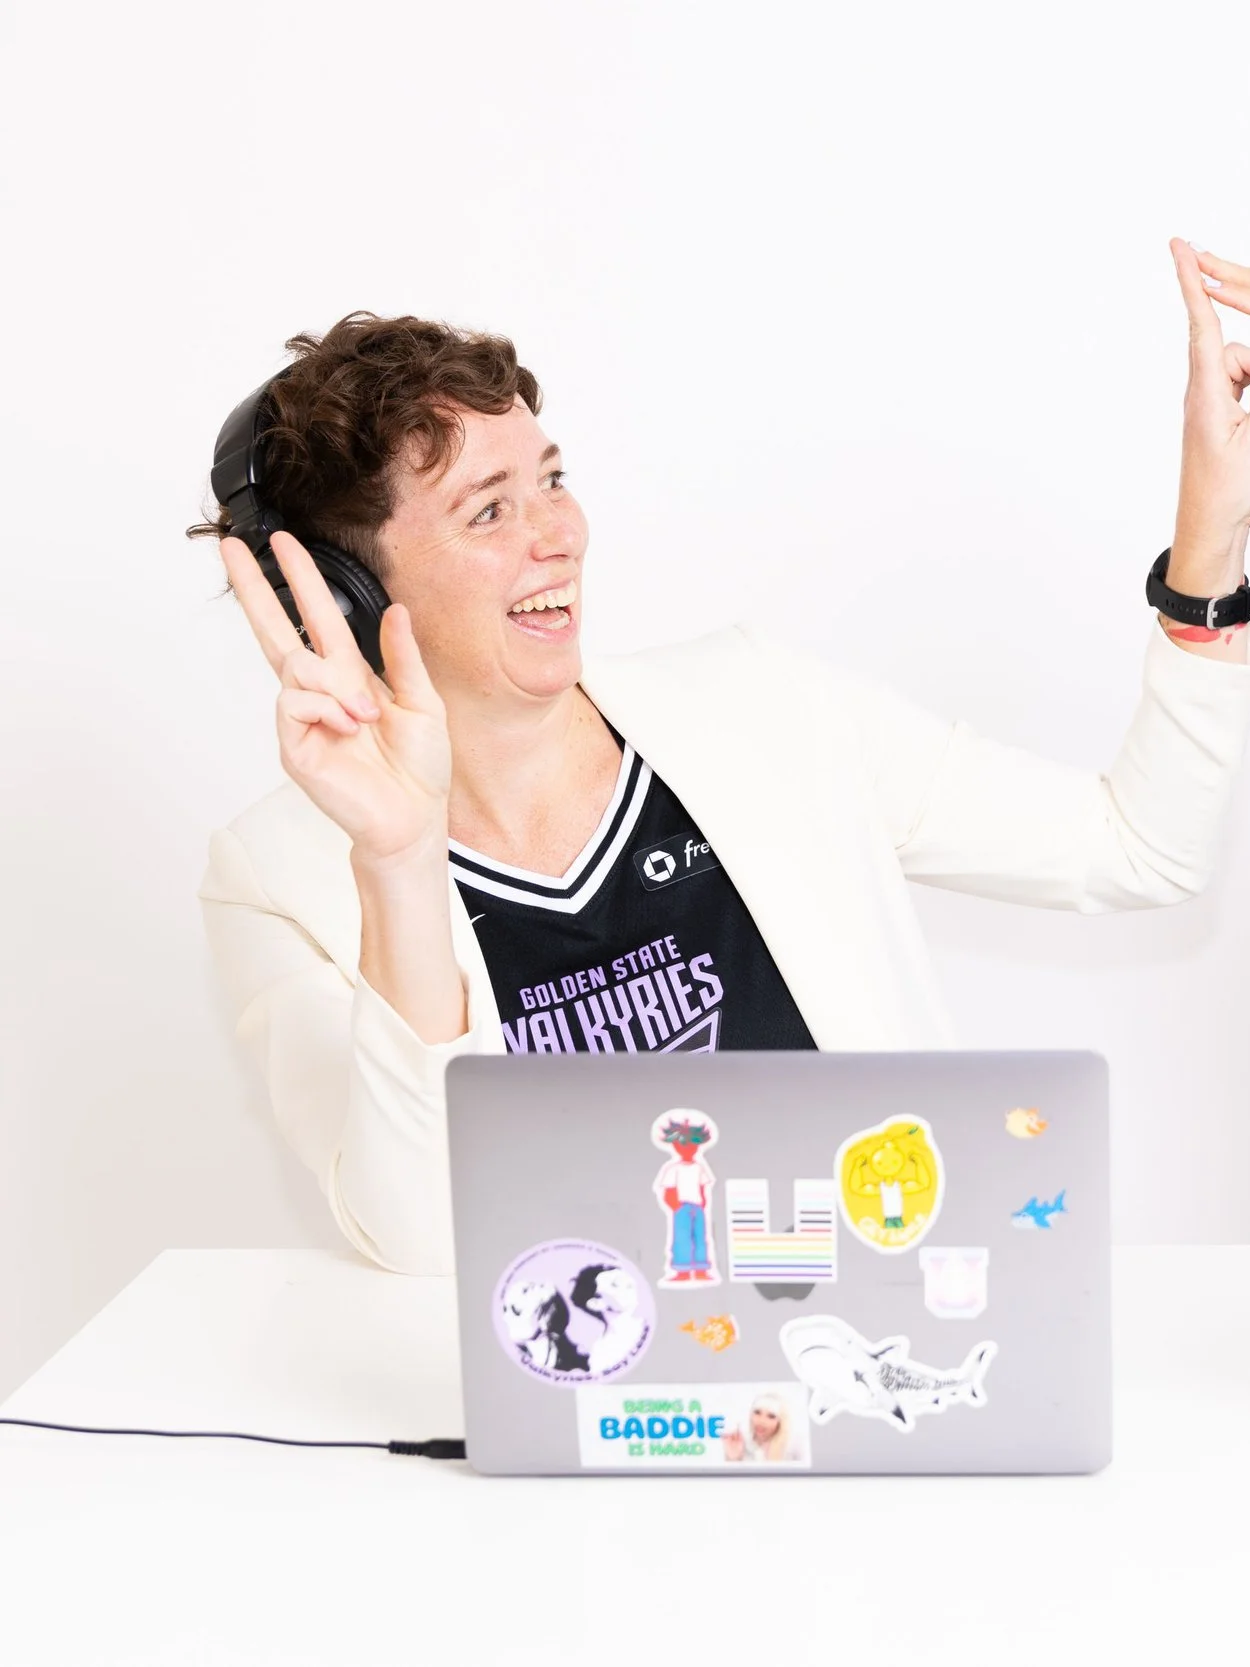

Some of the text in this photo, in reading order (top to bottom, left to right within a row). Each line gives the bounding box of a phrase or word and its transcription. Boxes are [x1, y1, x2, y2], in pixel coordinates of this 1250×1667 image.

[519, 934, 682, 1010] GOLDEN STATE
[501, 952, 724, 1055] VALKYRIES
[622, 1398, 703, 1414] BEING A
[600, 1415, 726, 1440] BADDIE
[628, 1442, 706, 1457] IS HARD
